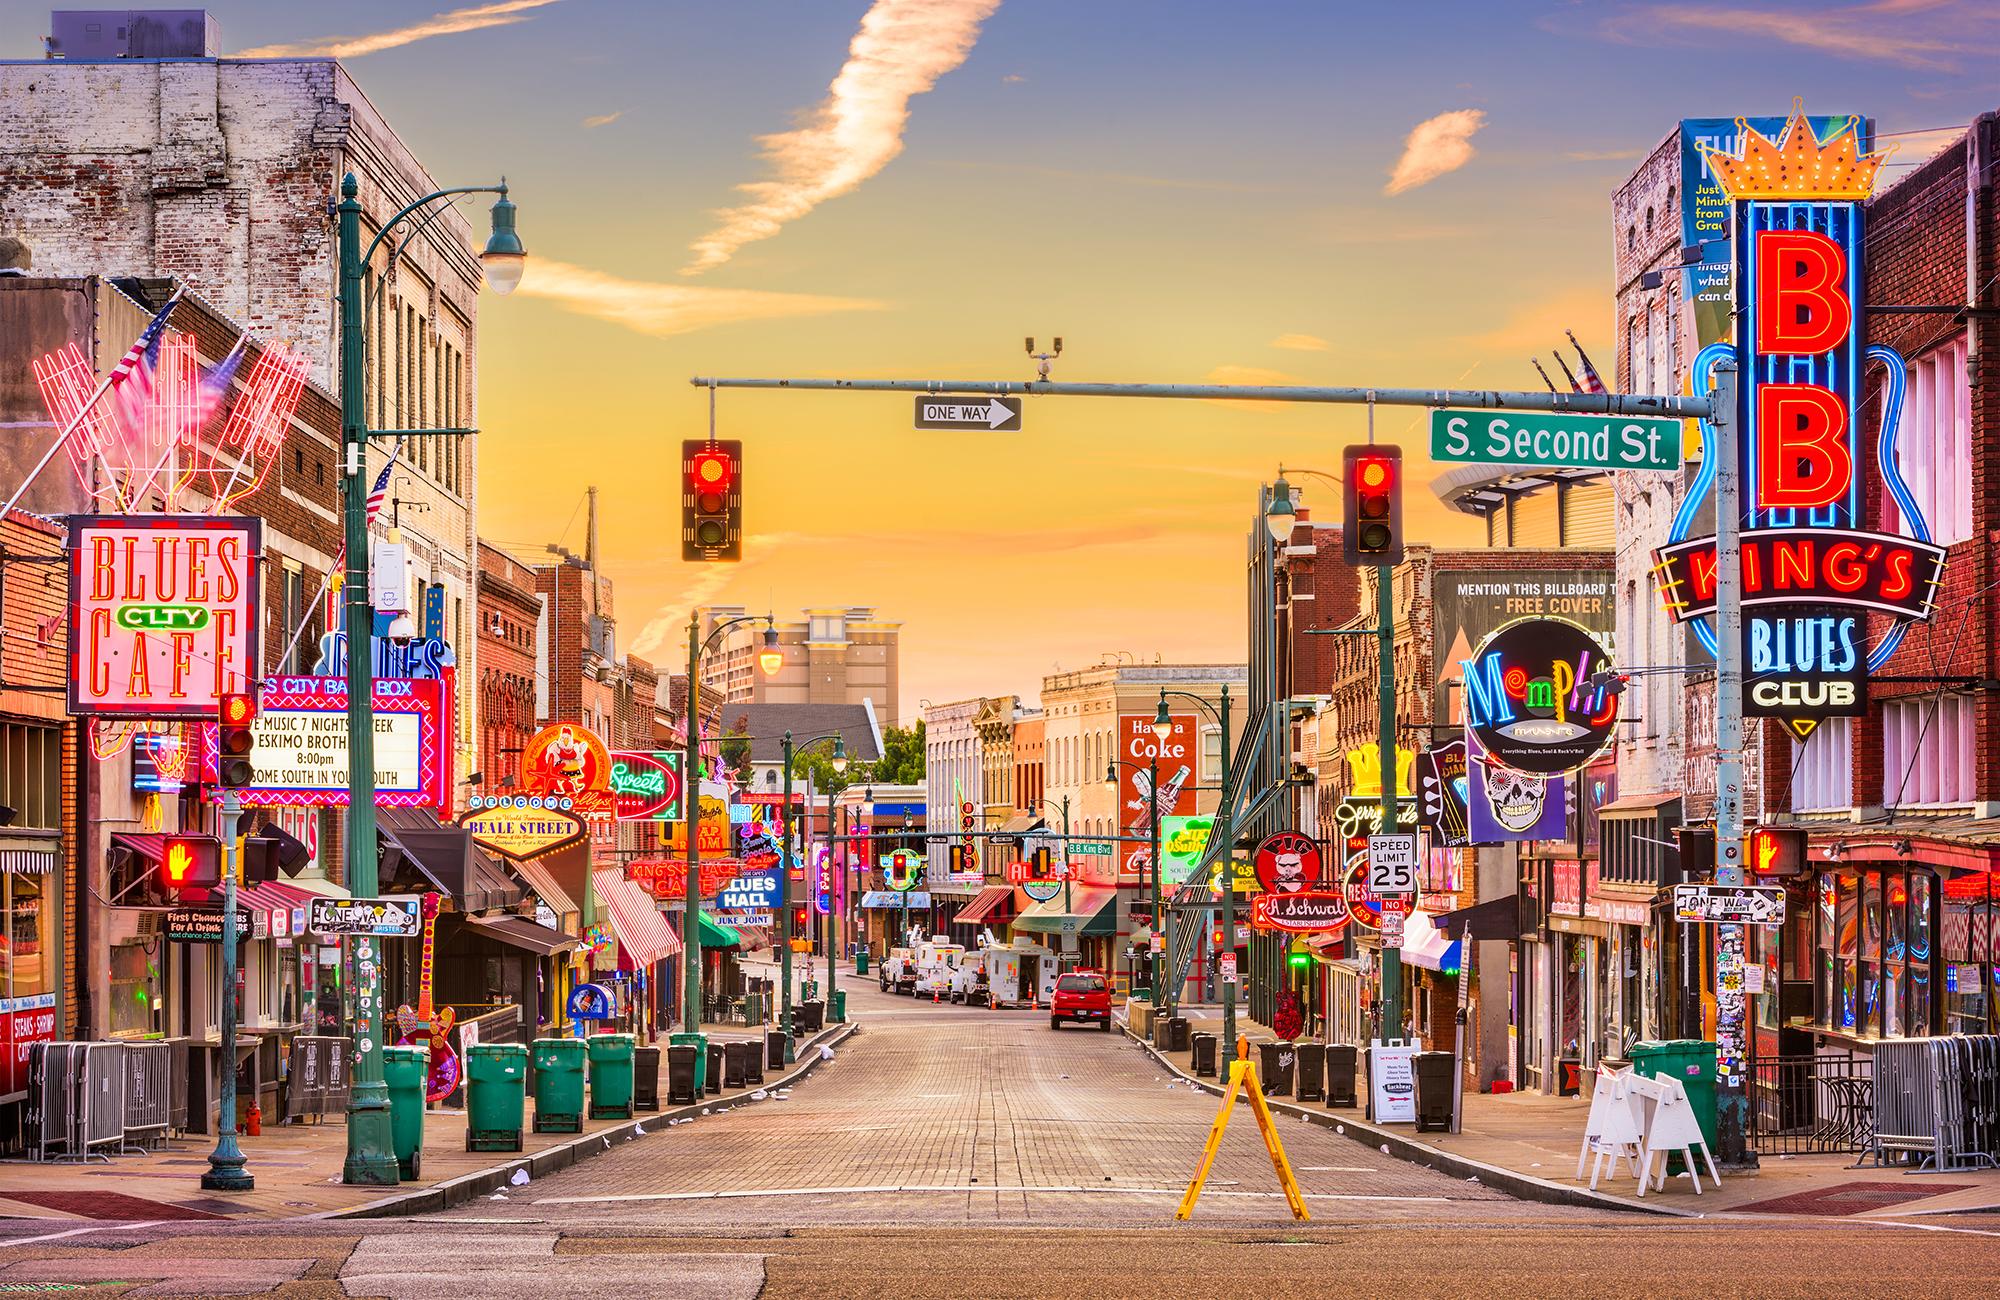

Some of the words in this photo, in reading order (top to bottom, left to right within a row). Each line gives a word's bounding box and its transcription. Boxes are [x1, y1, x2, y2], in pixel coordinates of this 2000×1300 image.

[1696, 184, 1719, 195] Just
[1696, 196, 1732, 207] Minut
[1696, 208, 1724, 219] from
[1698, 275, 1729, 286] what
[1698, 291, 1721, 302] can
[1757, 230, 1852, 356] B
[927, 406, 956, 419] ONE
[961, 406, 991, 420] WAY
[1445, 417, 1475, 456] S.
[1486, 419, 1609, 461] Second
[1619, 424, 1667, 464] St.
[1757, 384, 1852, 508] B
[90, 536, 239, 602] BLUES
[1689, 540, 1914, 600] KING'S
[1458, 583, 1510, 596] MENTION
[1514, 583, 1541, 596] THIS
[1544, 583, 1606, 596] BILLBOARD
[1506, 597, 1544, 614] FREE
[1549, 597, 1601, 614] COVER
[124, 607, 204, 625] CITY
[89, 607, 236, 698] CAFE
[1751, 618, 1856, 672] BLUES
[282, 678, 319, 694] CITY
[376, 681, 412, 696] BOX
[1752, 682, 1856, 706] CLUB
[264, 717, 297, 731] MUSIC
[301, 717, 307, 731] 7
[311, 717, 349, 732] NIGHTS
[373, 719, 393, 733] EEK
[1174, 724, 1184, 734] a
[258, 734, 303, 748] ESKIMO
[308, 735, 346, 750] BROTH
[1130, 738, 1185, 758] Coke
[297, 752, 334, 765] 8:00pm
[1445, 753, 1466, 763] BLA
[282, 769, 314, 784] SOUTH
[317, 770, 329, 783] IN
[332, 770, 350, 784] YOU
[374, 771, 398, 785] OUTH
[1442, 763, 1466, 778] DIAM
[611, 764, 665, 795] Sweets
[581, 811, 612, 821] CAFE
[469, 821, 515, 834] BEALE
[519, 821, 573, 834] STREET
[699, 826, 720, 837] AP
[679, 837, 721, 850] ROM
[1069, 843, 1082, 854] B.B.
[1083, 843, 1096, 855] King
[1097, 843, 1112, 855] Blvd.
[1262, 836, 1314, 856] PIG
[1350, 837, 1369, 848] HAL
[1372, 841, 1411, 851] SPEED
[1376, 853, 1406, 863] LIMIT
[633, 863, 676, 878] KING'S
[1373, 865, 1411, 887] 25
[656, 879, 714, 894] CAE
[724, 877, 776, 892] LUES
[723, 893, 770, 907] HALL
[1266, 897, 1284, 916] A.
[1286, 896, 1345, 916] Schwab
[1385, 901, 1399, 910] NO
[167, 913, 190, 922] First
[717, 916, 739, 926] JUKE
[743, 915, 769, 925] JOINT
[1352, 905, 1371, 922] 159
[170, 922, 186, 932] For
[186, 922, 194, 932] A
[195, 923, 222, 933] Drink
[1063, 922, 1075, 930] 25
[14, 1016, 34, 1039] STEAKS
